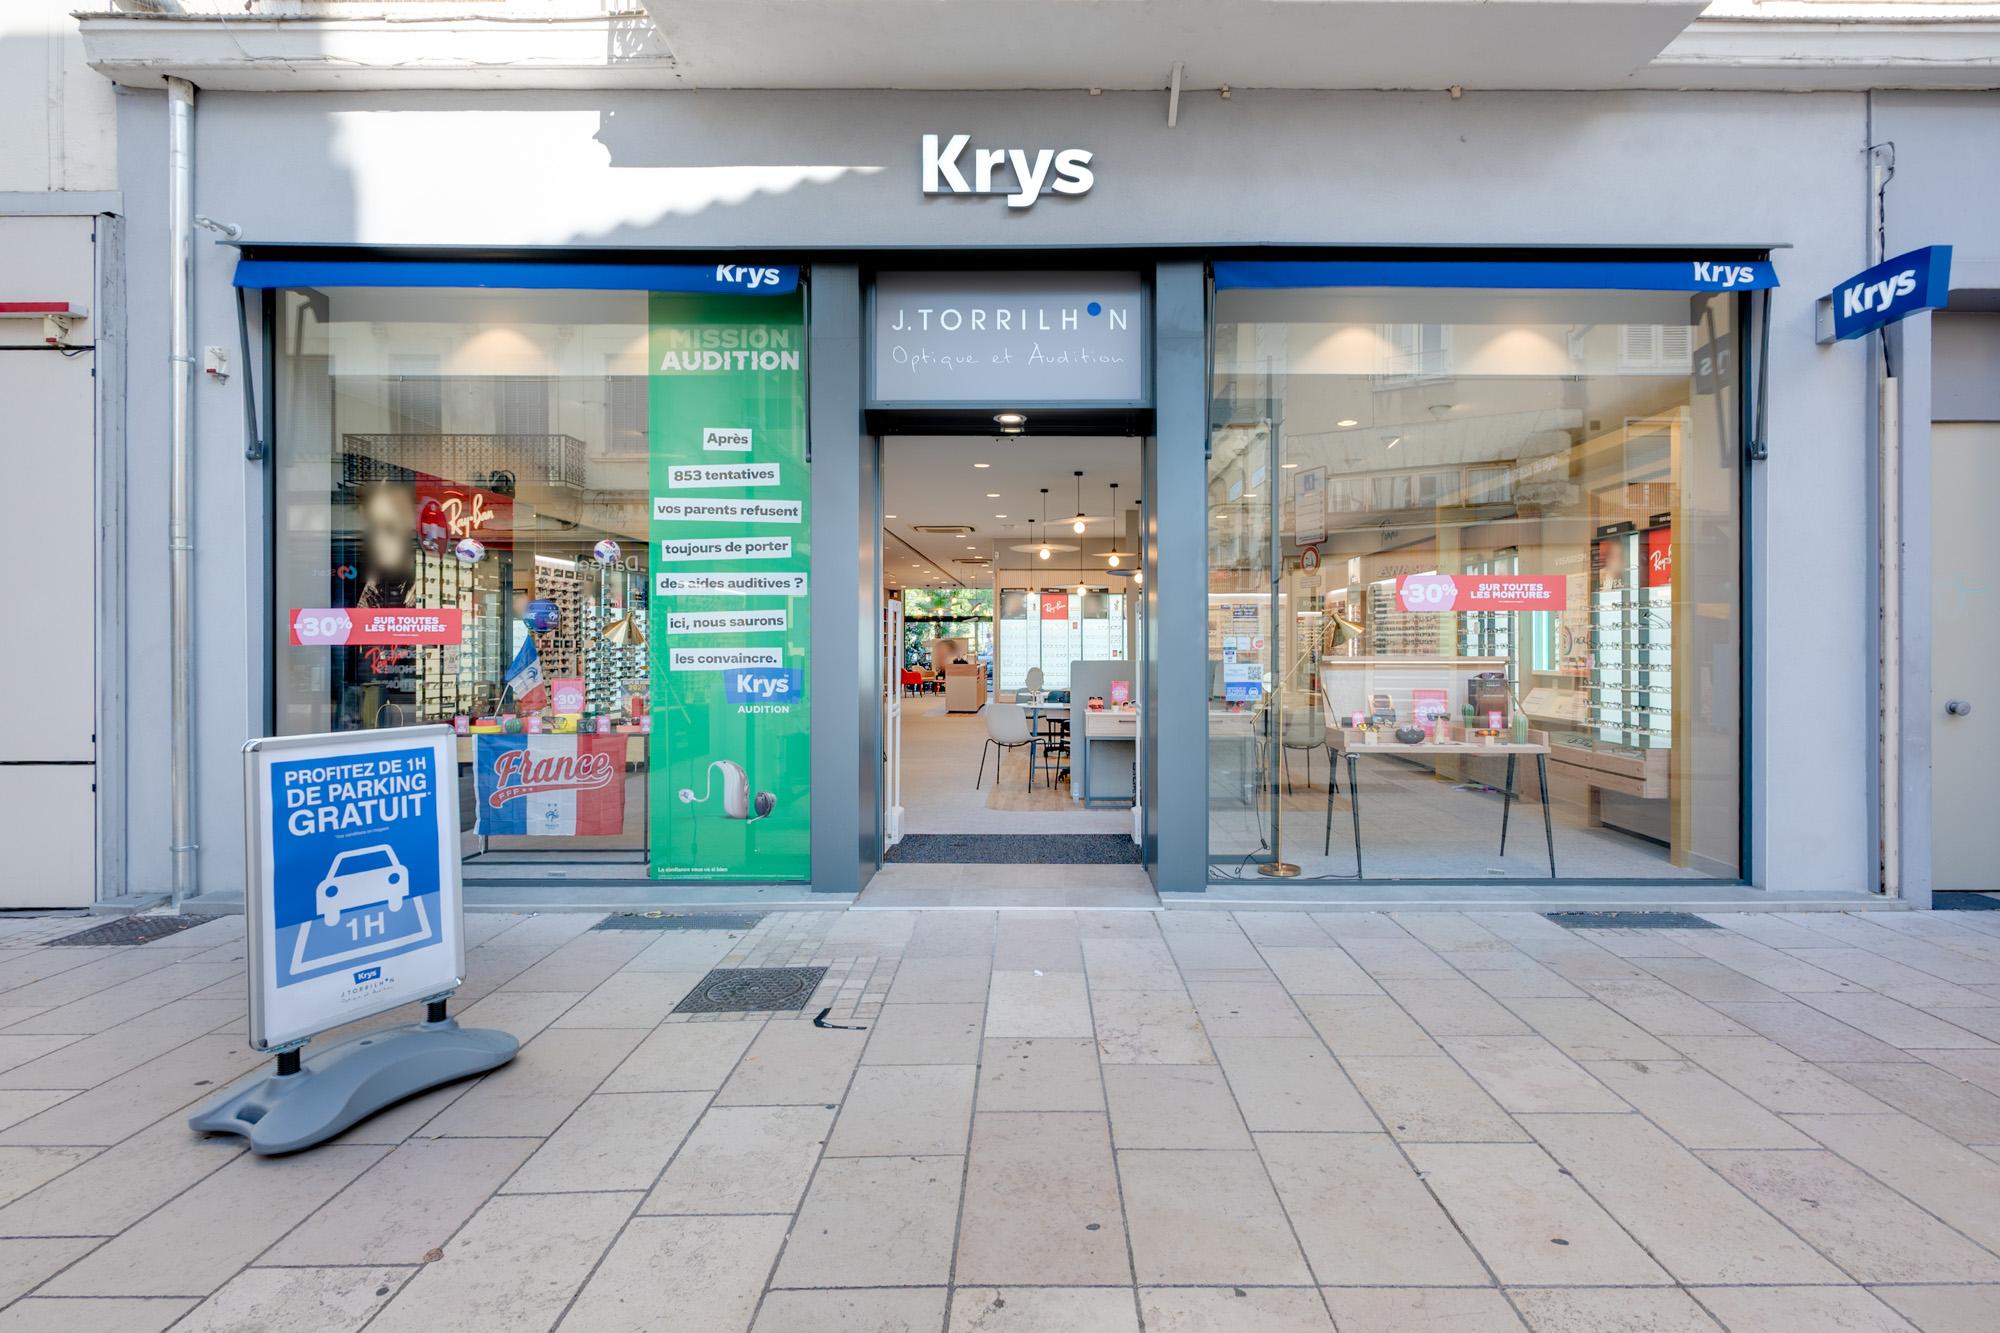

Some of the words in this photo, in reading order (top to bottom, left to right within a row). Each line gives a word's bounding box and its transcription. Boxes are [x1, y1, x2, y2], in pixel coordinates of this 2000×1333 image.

[922, 134, 1094, 208] Krys
[716, 264, 780, 288] Krys
[1694, 261, 1755, 287] Krys
[1843, 269, 1917, 318] Krys
[670, 328, 789, 349] MISSION
[660, 351, 800, 371] AUDITION
[892, 345, 979, 375] Optique
[992, 347, 1013, 364] et
[1028, 342, 1125, 366] Audition
[706, 433, 749, 447] Après
[673, 470, 702, 481] 853
[705, 468, 775, 481] tentatives
[657, 504, 681, 514] vos
[684, 505, 737, 517] parents
[740, 505, 799, 517] refusent
[665, 543, 722, 556] toujours
[725, 541, 742, 552] de
[745, 541, 789, 554] porter
[660, 578, 685, 589] des
[687, 578, 725, 589] aides
[728, 578, 791, 589] auditives
[794, 577, 804, 589] ?
[1400, 583, 1458, 603] -30%
[1478, 583, 1500, 591] SUR
[1502, 583, 1543, 591] TOUTES
[1470, 591, 1490, 599] LES
[293, 616, 353, 637] -30%
[365, 624, 385, 632] LES
[373, 616, 395, 625] SUR
[397, 616, 439, 625] TOUTES
[669, 617, 690, 630] ici,
[693, 618, 726, 628] nous
[729, 616, 784, 627] saurons
[675, 653, 694, 664] les
[697, 653, 777, 664] convaincre.
[737, 674, 789, 697] Krys
[737, 705, 790, 714] AUDITION
[284, 762, 375, 786] PROFITEZ
[378, 759, 402, 775] DE
[407, 756, 426, 771] 1H
[494, 749, 611, 789] France
[287, 786, 322, 808] DE
[328, 773, 427, 802] PARKING
[345, 911, 386, 942] 1H
[358, 970, 377, 981] Krys
